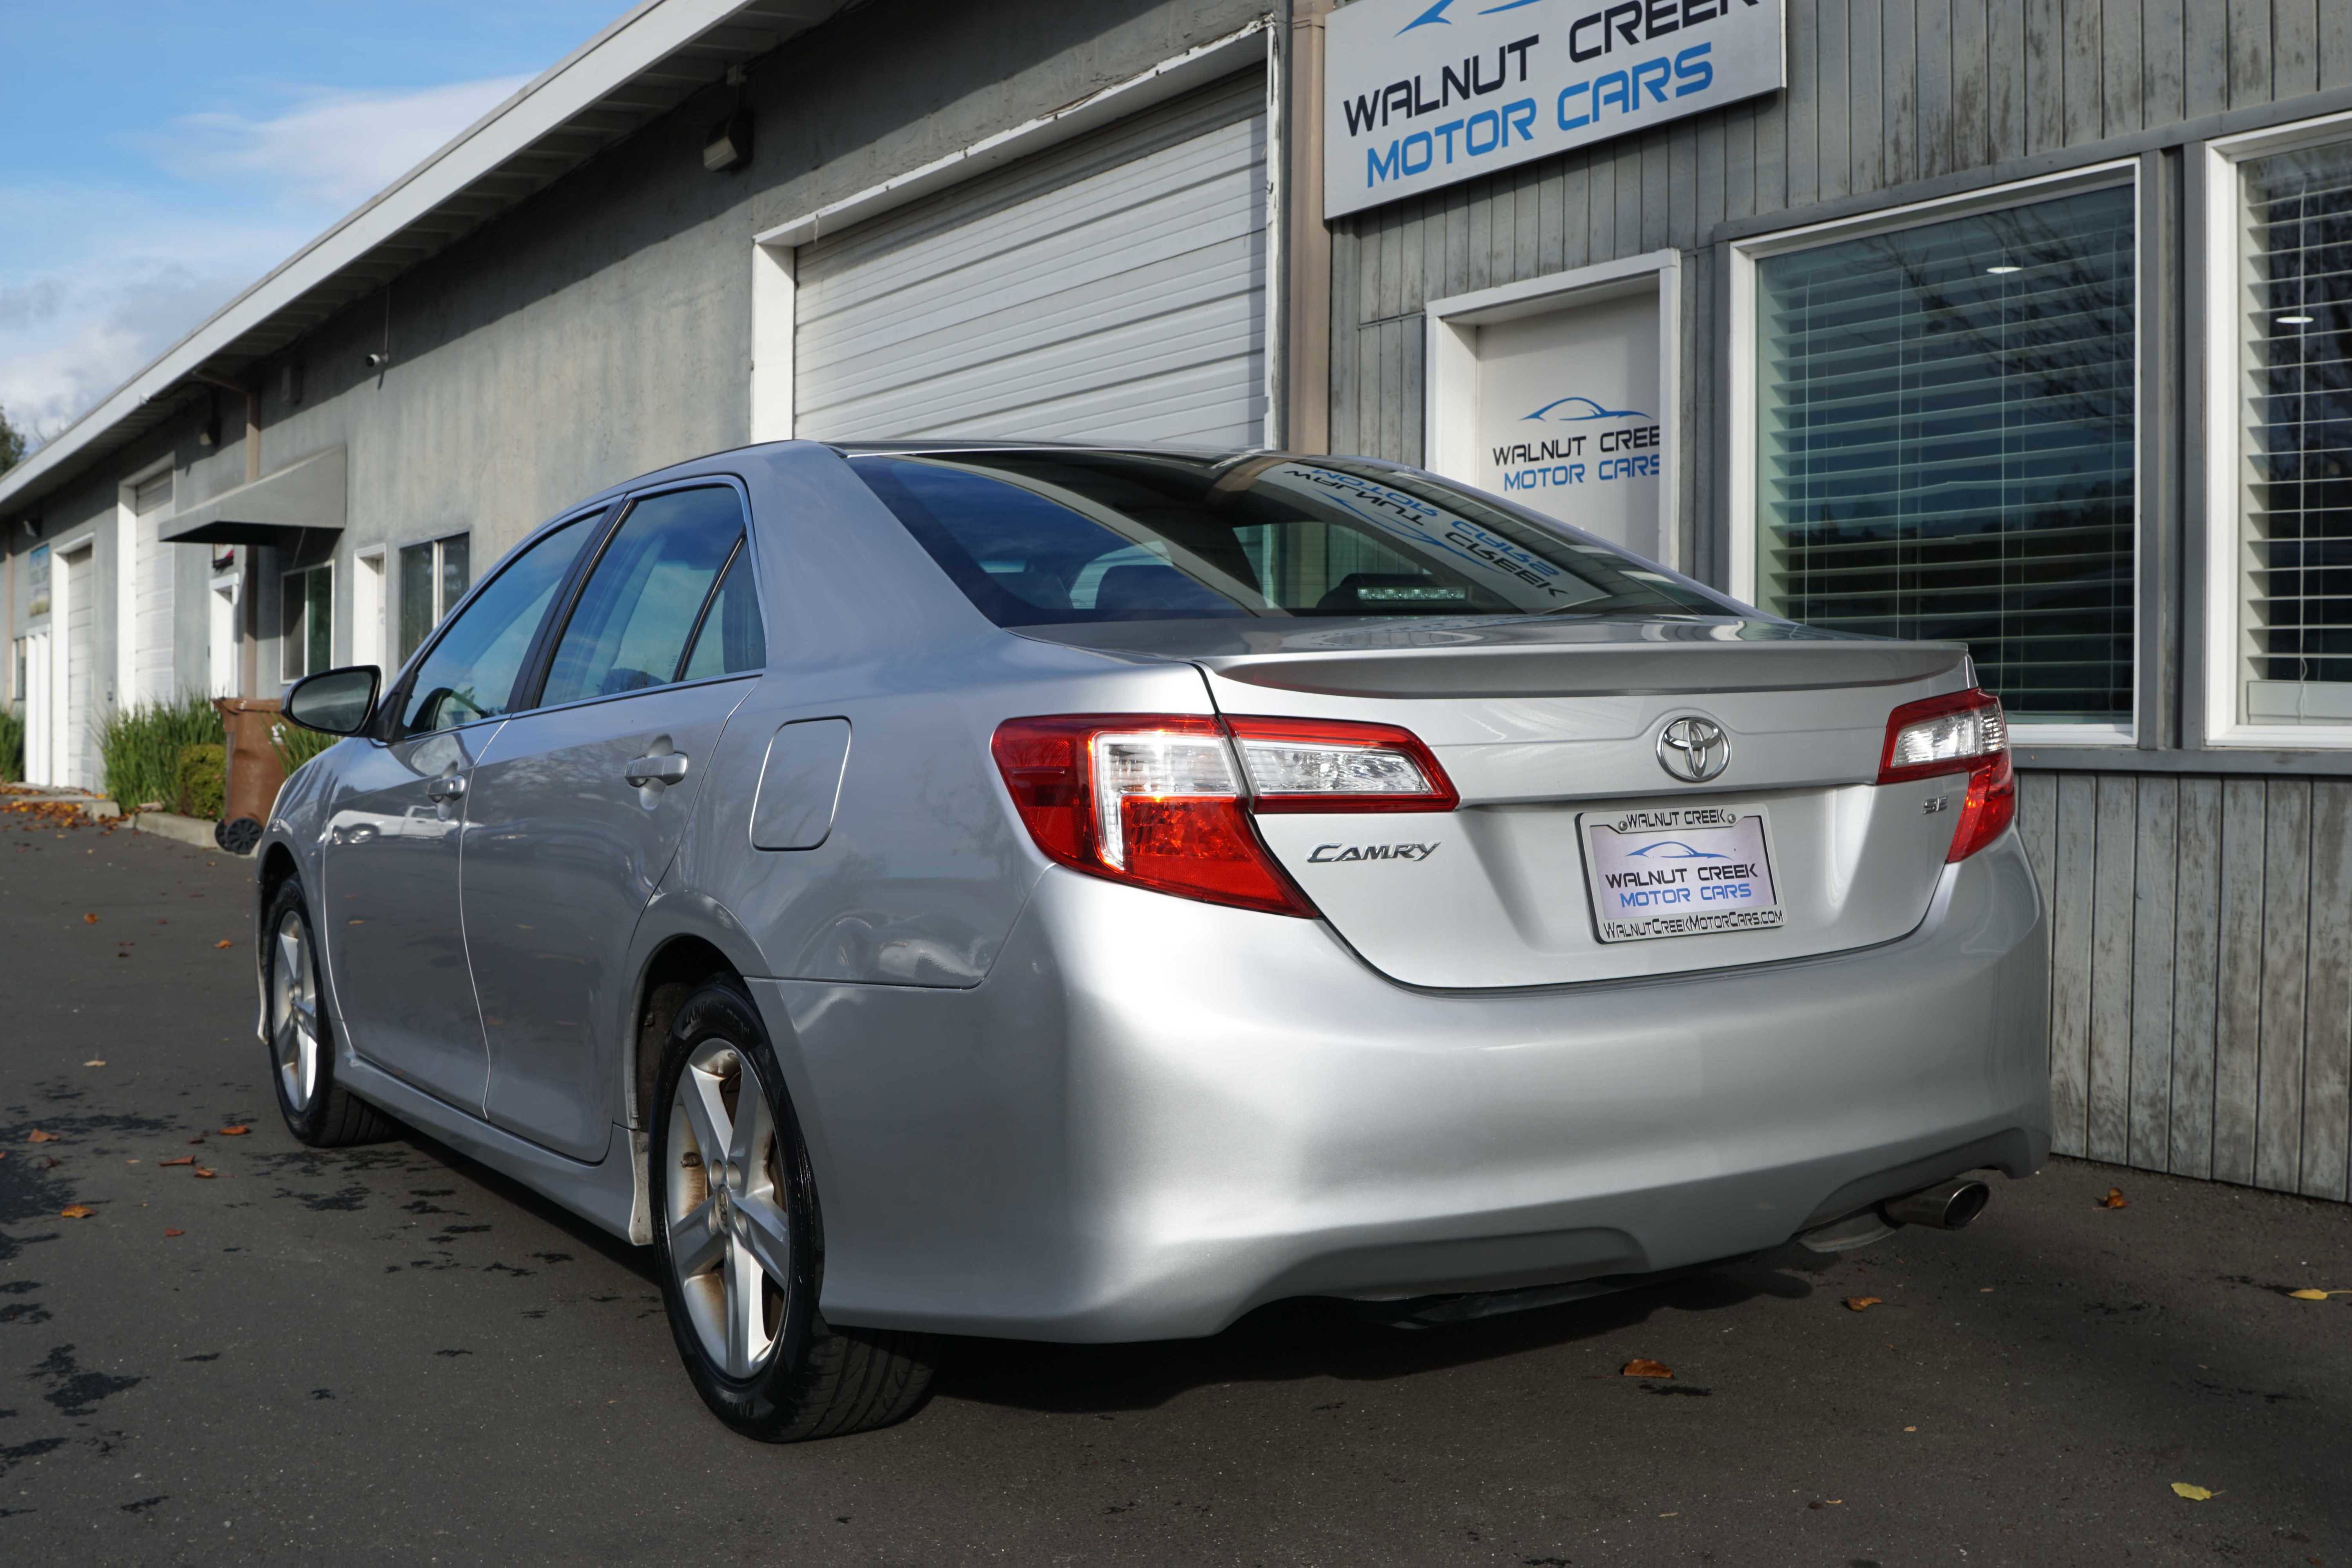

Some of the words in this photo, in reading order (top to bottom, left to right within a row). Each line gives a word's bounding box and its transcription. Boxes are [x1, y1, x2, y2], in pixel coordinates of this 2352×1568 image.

[1343, 34, 1539, 137] WALNUT
[1367, 98, 1537, 187] MOTOR
[1557, 42, 1713, 131] CARS
[1493, 436, 1586, 466] WALNUT
[1600, 425, 1660, 452] CREE
[1504, 463, 1586, 492] MOTOR
[1599, 454, 1660, 481] CARS
[1626, 811, 1679, 828] WALNUT
[1684, 809, 1726, 825] CREEK
[1922, 796, 1947, 815] SE
[1307, 841, 1441, 863] CAMRY
[1605, 868, 1687, 889] WALNUT
[1697, 863, 1758, 881] CREEK
[1620, 888, 1691, 908] MOTOR
[1700, 883, 1752, 900] CARS
